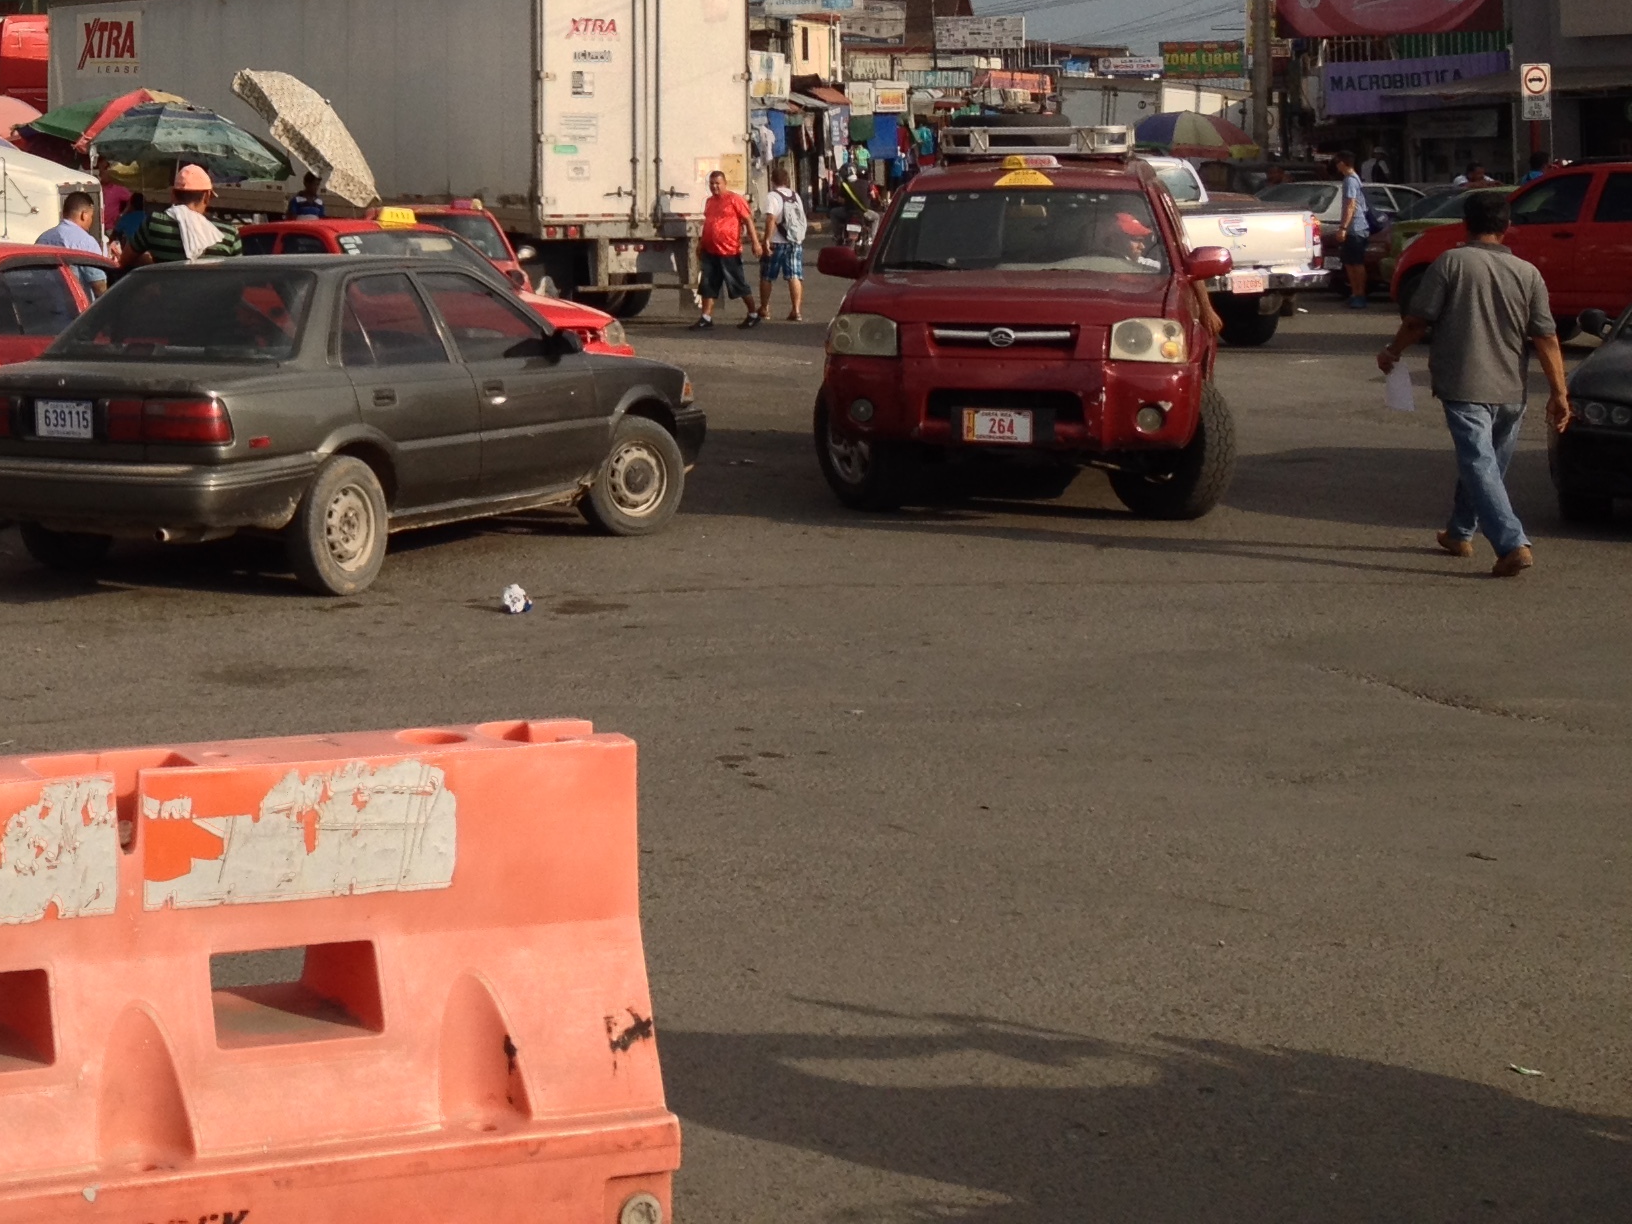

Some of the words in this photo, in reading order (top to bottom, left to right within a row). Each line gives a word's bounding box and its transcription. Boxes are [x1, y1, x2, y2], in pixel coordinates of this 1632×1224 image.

[565, 17, 618, 40] XTRA
[77, 18, 135, 70] XTRA
[97, 65, 140, 74] LEASE
[1164, 52, 1198, 66] ZONA
[1202, 52, 1239, 66] LIBRE
[1330, 68, 1463, 92] MACROBIOTICA
[44, 408, 89, 430] 639115
[988, 417, 1015, 435] 264
